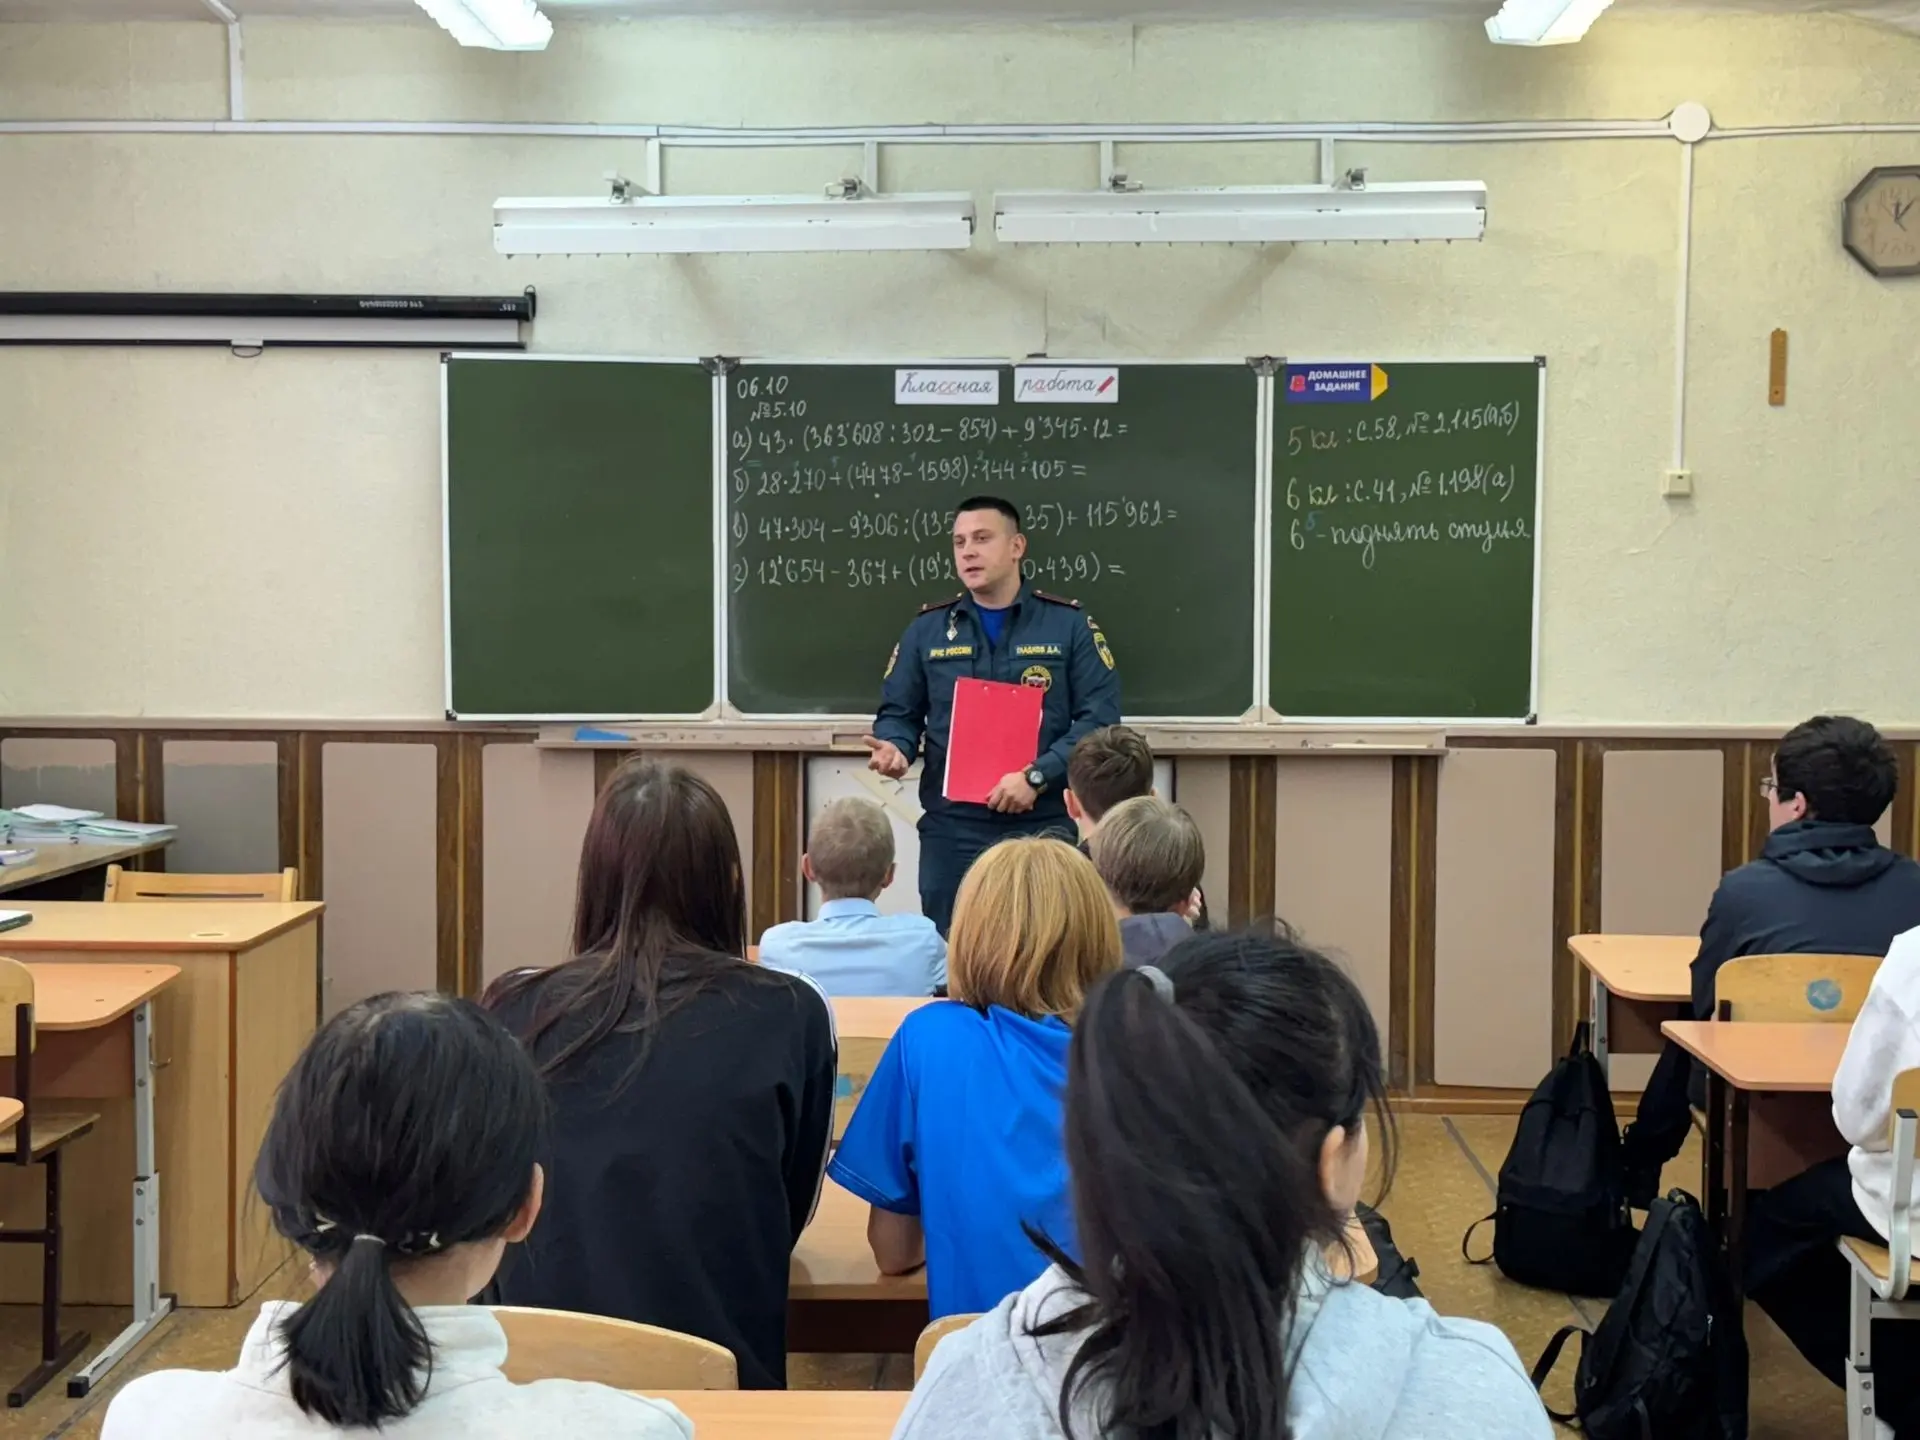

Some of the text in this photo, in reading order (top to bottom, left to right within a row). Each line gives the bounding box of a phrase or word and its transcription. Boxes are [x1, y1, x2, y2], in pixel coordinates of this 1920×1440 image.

[899, 369, 1097, 399] Классная работа
[1308, 370, 1367, 381] ДОМАШНЕЕ
[736, 375, 789, 399] 06.10
[1314, 382, 1361, 393] ЗАДАНИЕ
